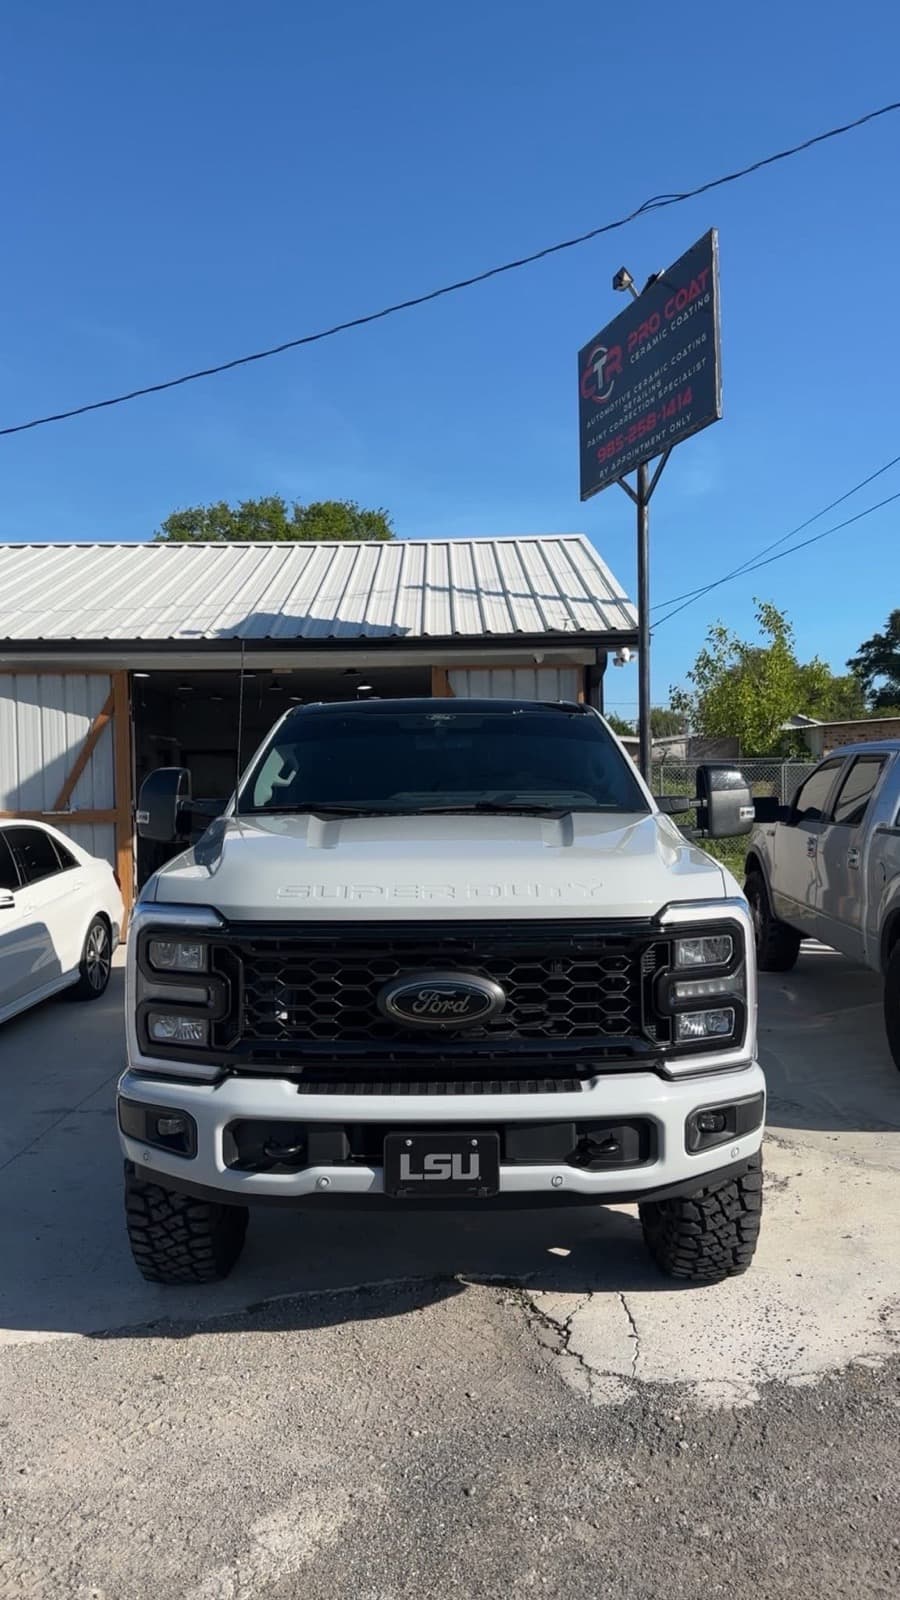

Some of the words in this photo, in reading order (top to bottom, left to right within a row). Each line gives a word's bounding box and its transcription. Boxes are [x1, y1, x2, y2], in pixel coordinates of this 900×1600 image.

[627, 311, 660, 352] PRO
[665, 267, 709, 319] COAT
[630, 329, 667, 364] CERAMIC
[670, 292, 710, 331] COATING
[581, 344, 623, 399] CTR
[586, 390, 631, 429] AUTOMOTIVE
[633, 362, 668, 394] CERAMIC
[671, 332, 707, 365] COATING
[587, 430, 607, 448] PAINT
[609, 397, 656, 433] CORRECTION
[658, 357, 707, 399] SPECIALIST
[623, 380, 662, 413] DETAILING
[596, 386, 693, 463] 985-258-1414
[599, 466, 609, 479] BY
[611, 429, 666, 471] APPOINTMENT
[669, 413, 692, 432] ONLY
[277, 882, 455, 900] SUPER
[466, 880, 604, 898] DUTY
[412, 989, 470, 1013] Ford
[400, 1153, 480, 1180] LSU
